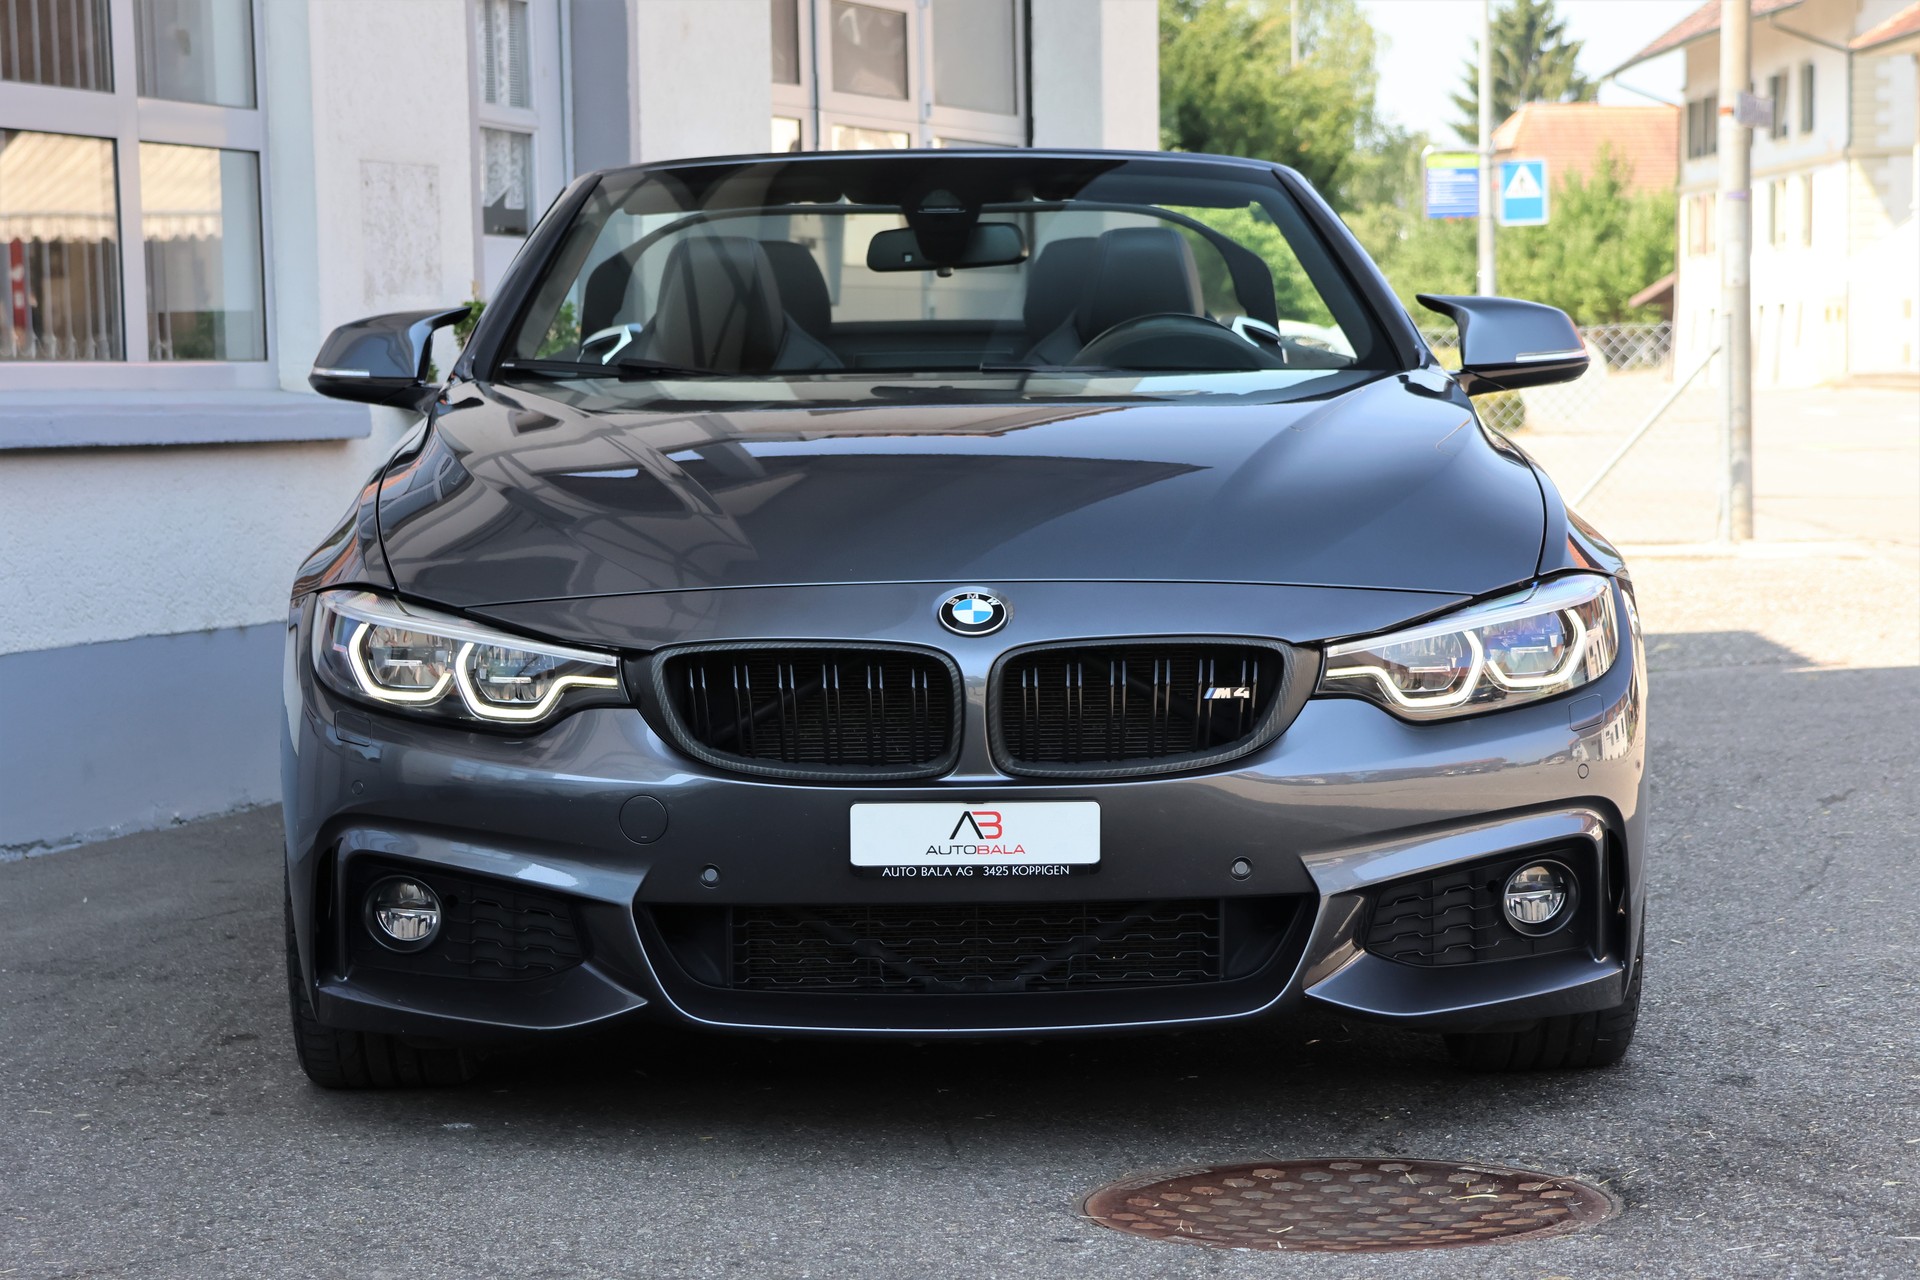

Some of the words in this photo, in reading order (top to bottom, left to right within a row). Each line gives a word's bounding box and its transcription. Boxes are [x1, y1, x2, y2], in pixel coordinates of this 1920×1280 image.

[947, 593, 1000, 605] BMW
[1205, 688, 1250, 699] M4
[925, 844, 1026, 855] AUTOBALA
[882, 867, 917, 877] AUTO
[921, 867, 952, 877] BALA
[956, 867, 974, 877] AG
[983, 866, 1009, 876] 3425
[1012, 865, 1070, 876] KOPPIGEN
